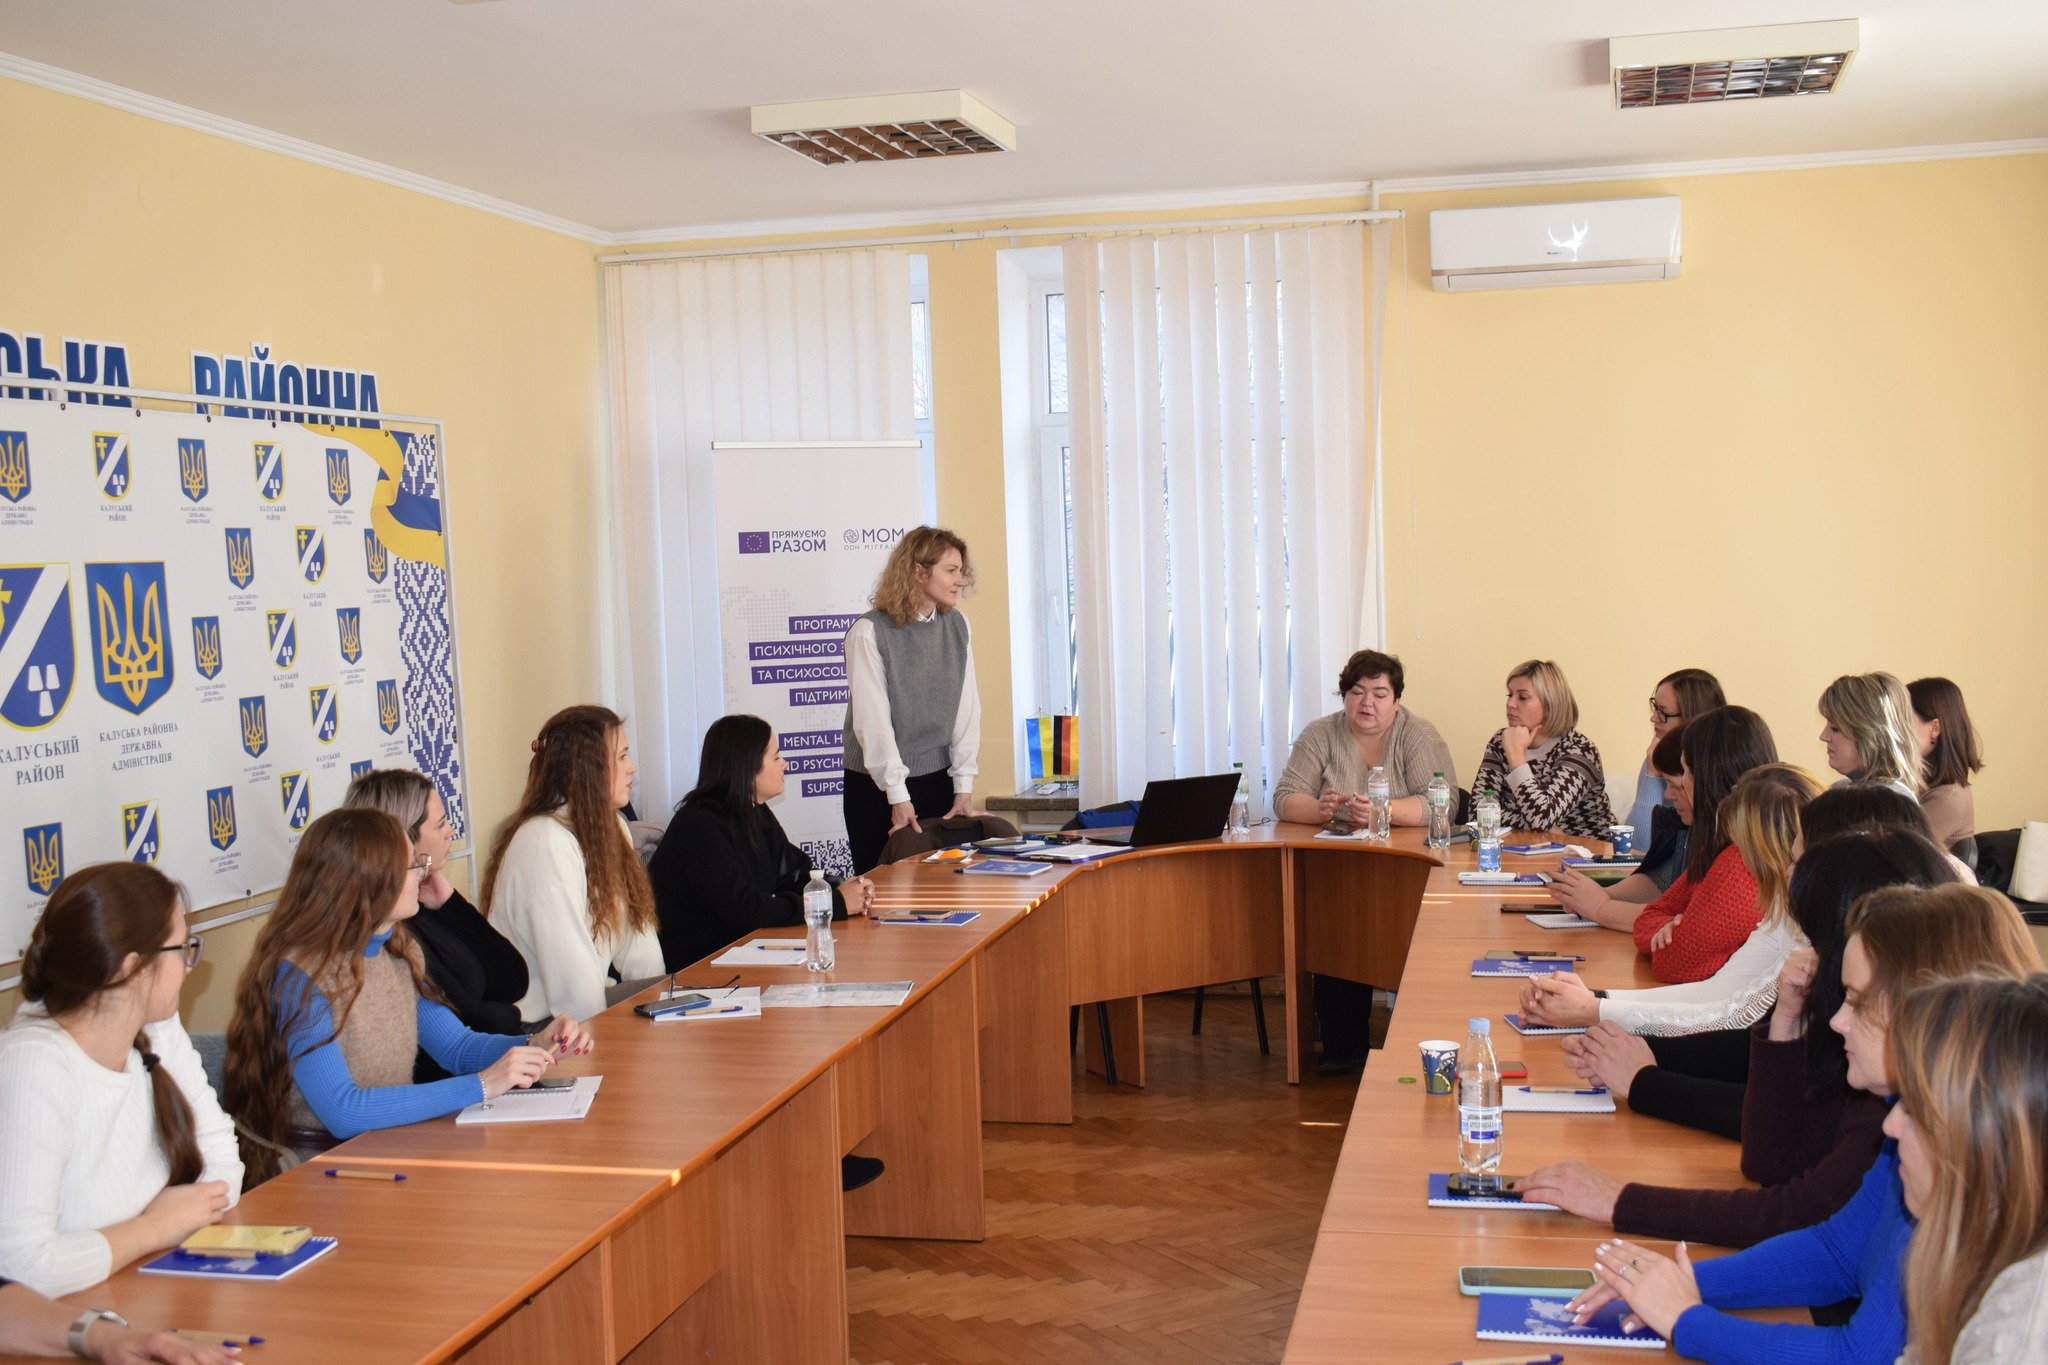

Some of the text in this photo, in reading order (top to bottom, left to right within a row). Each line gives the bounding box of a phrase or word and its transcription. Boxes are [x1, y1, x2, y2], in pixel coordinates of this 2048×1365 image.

[193, 345, 381, 430] РАЙОННА
[771, 529, 827, 539] ПРЯМУЄМО
[862, 528, 905, 543] МОМ
[772, 539, 827, 553] РАЗОМ
[755, 642, 837, 657] ПСИХІЧНОГО
[757, 670, 773, 681] ТА
[99, 722, 179, 742] КАЛУСЬКА РАЙОННА
[121, 740, 162, 755] ДЕРЖАВНА
[783, 735, 831, 747] MENTAL
[112, 752, 173, 771] АДМІНІСТРАЦІЯ
[16, 764, 65, 785] РАЙОН
